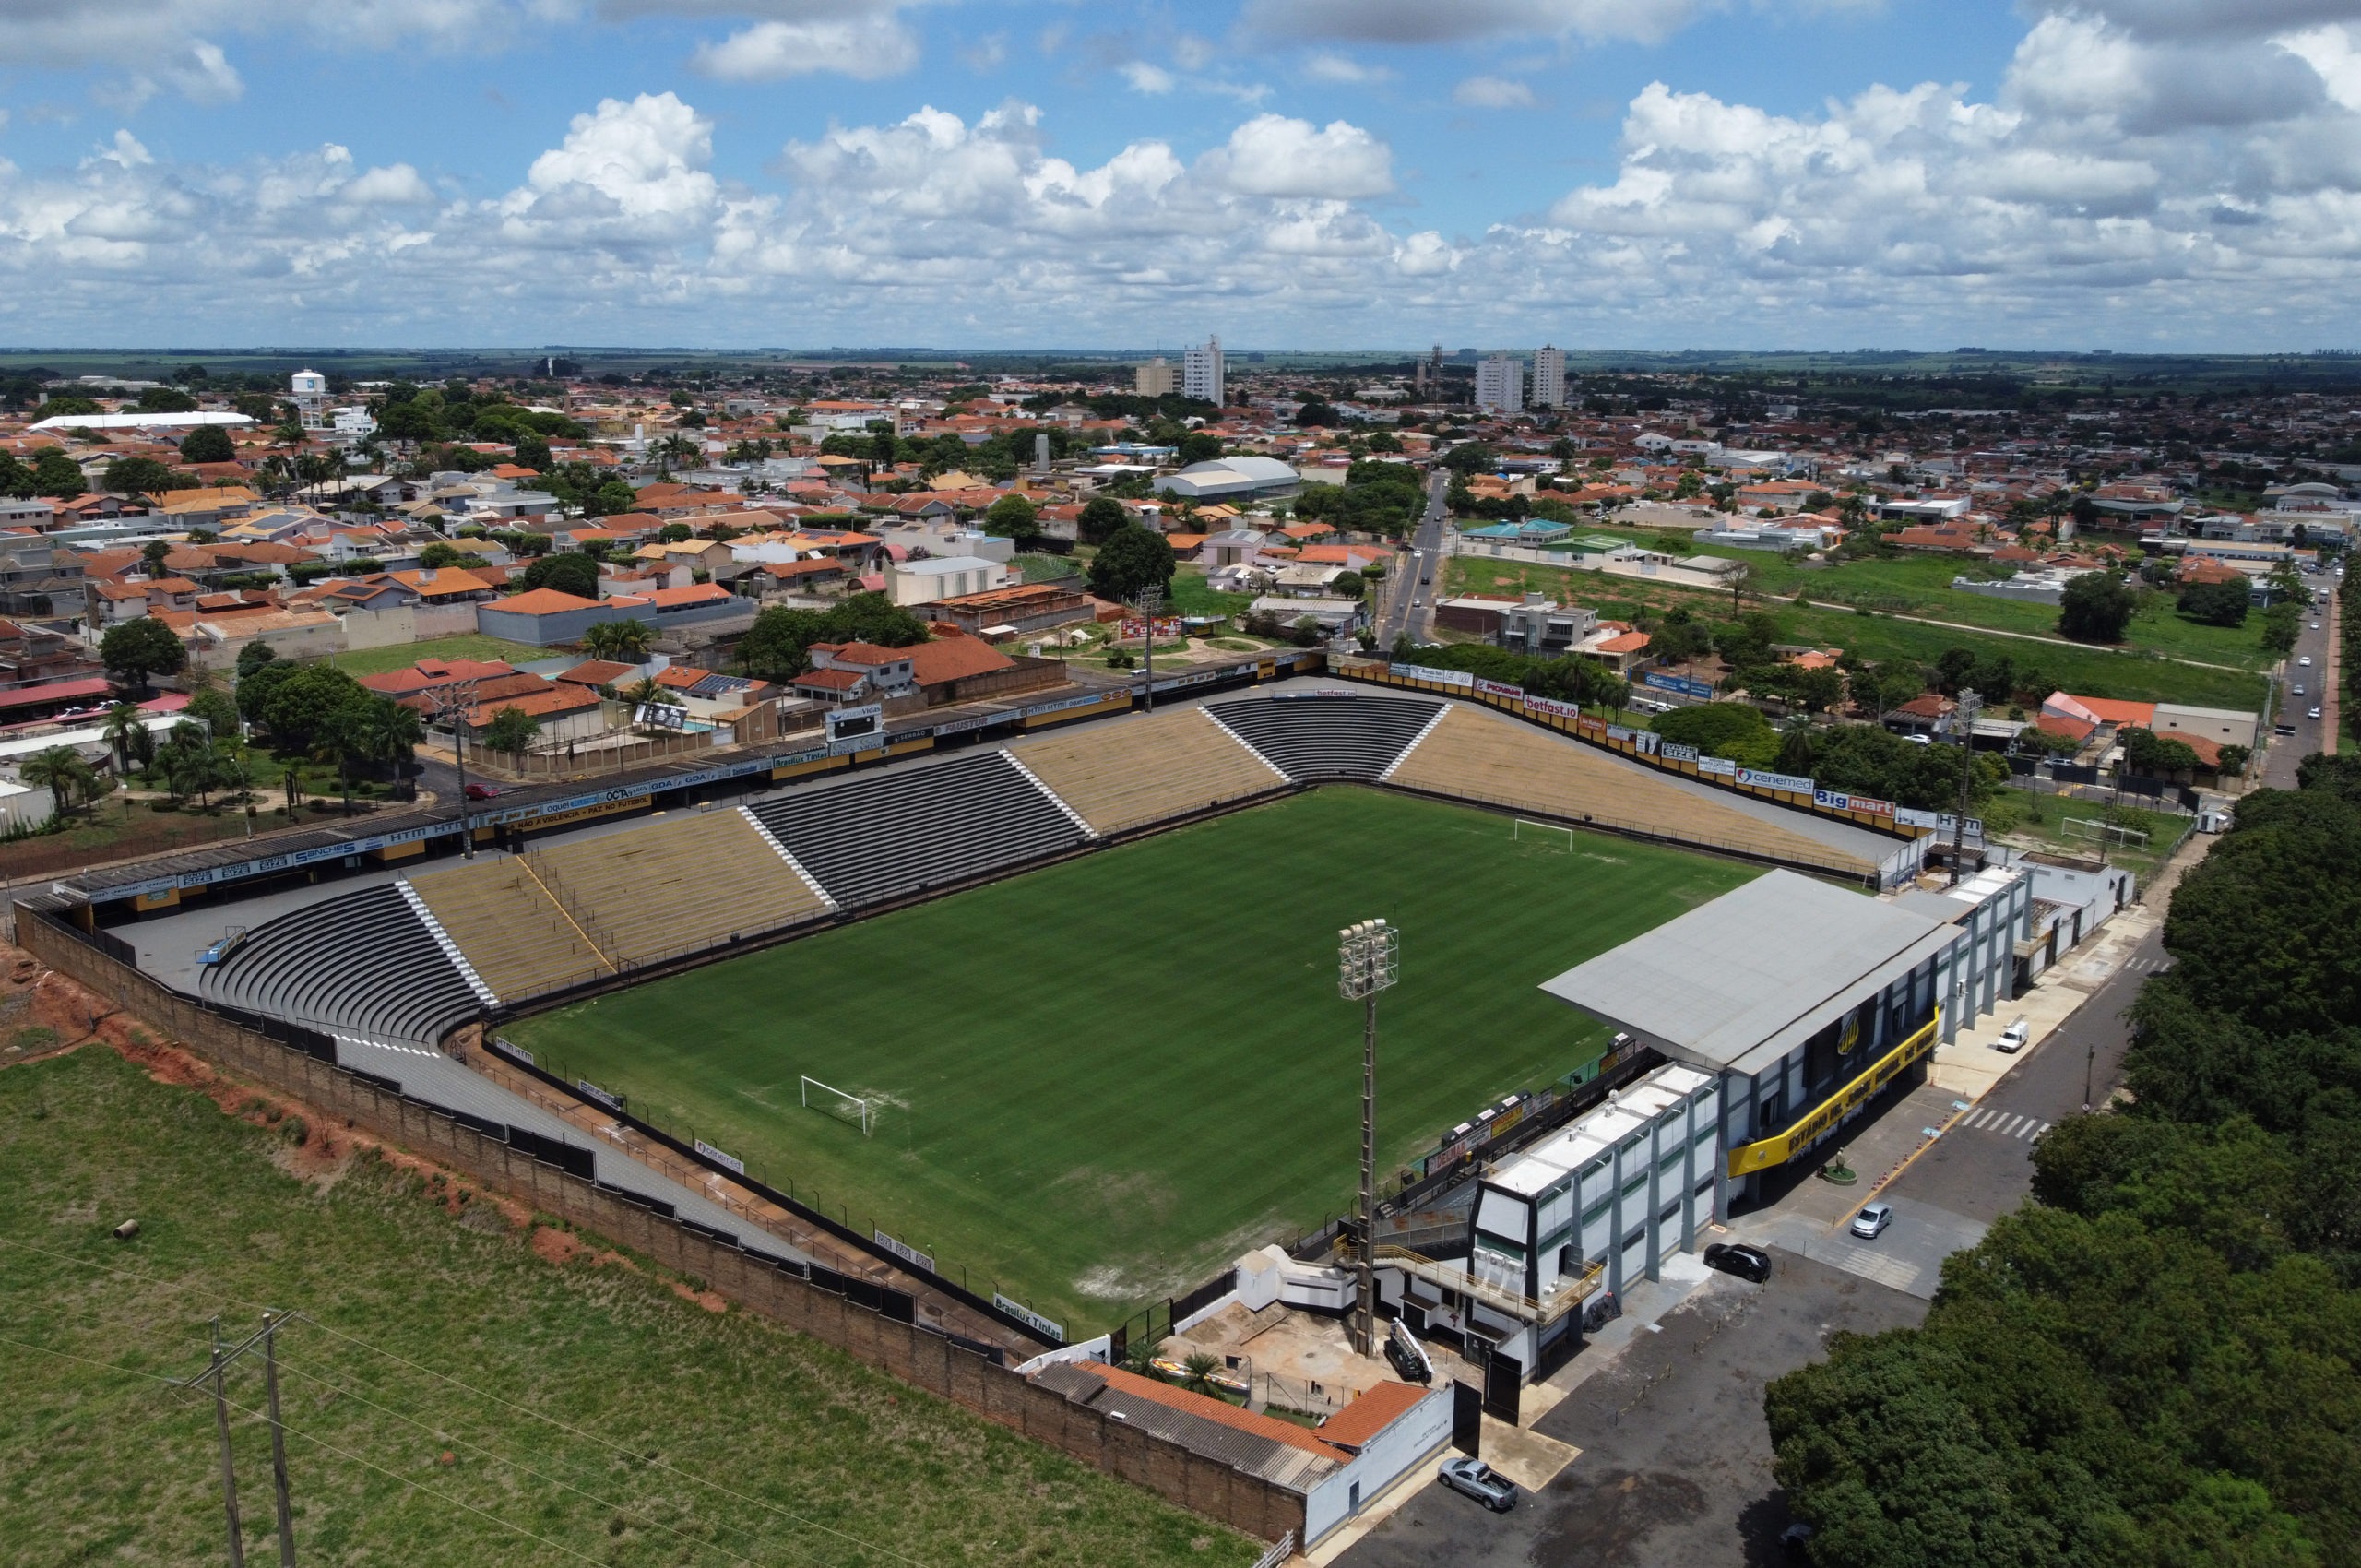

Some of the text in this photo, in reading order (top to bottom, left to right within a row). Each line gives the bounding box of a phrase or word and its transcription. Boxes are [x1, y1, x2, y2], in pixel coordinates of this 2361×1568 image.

[1526, 695, 1576, 718] betfast.io
[776, 756, 804, 767] Brasilux
[806, 753, 827, 762] Tintas
[1666, 749, 1694, 759] SIZE
[685, 774, 706, 783] GDA
[1754, 773, 1811, 790] cenemed
[651, 781, 673, 790] GDA
[618, 797, 648, 808] FUTEBOL
[996, 1298, 1061, 1340] Brasilux Tintas
